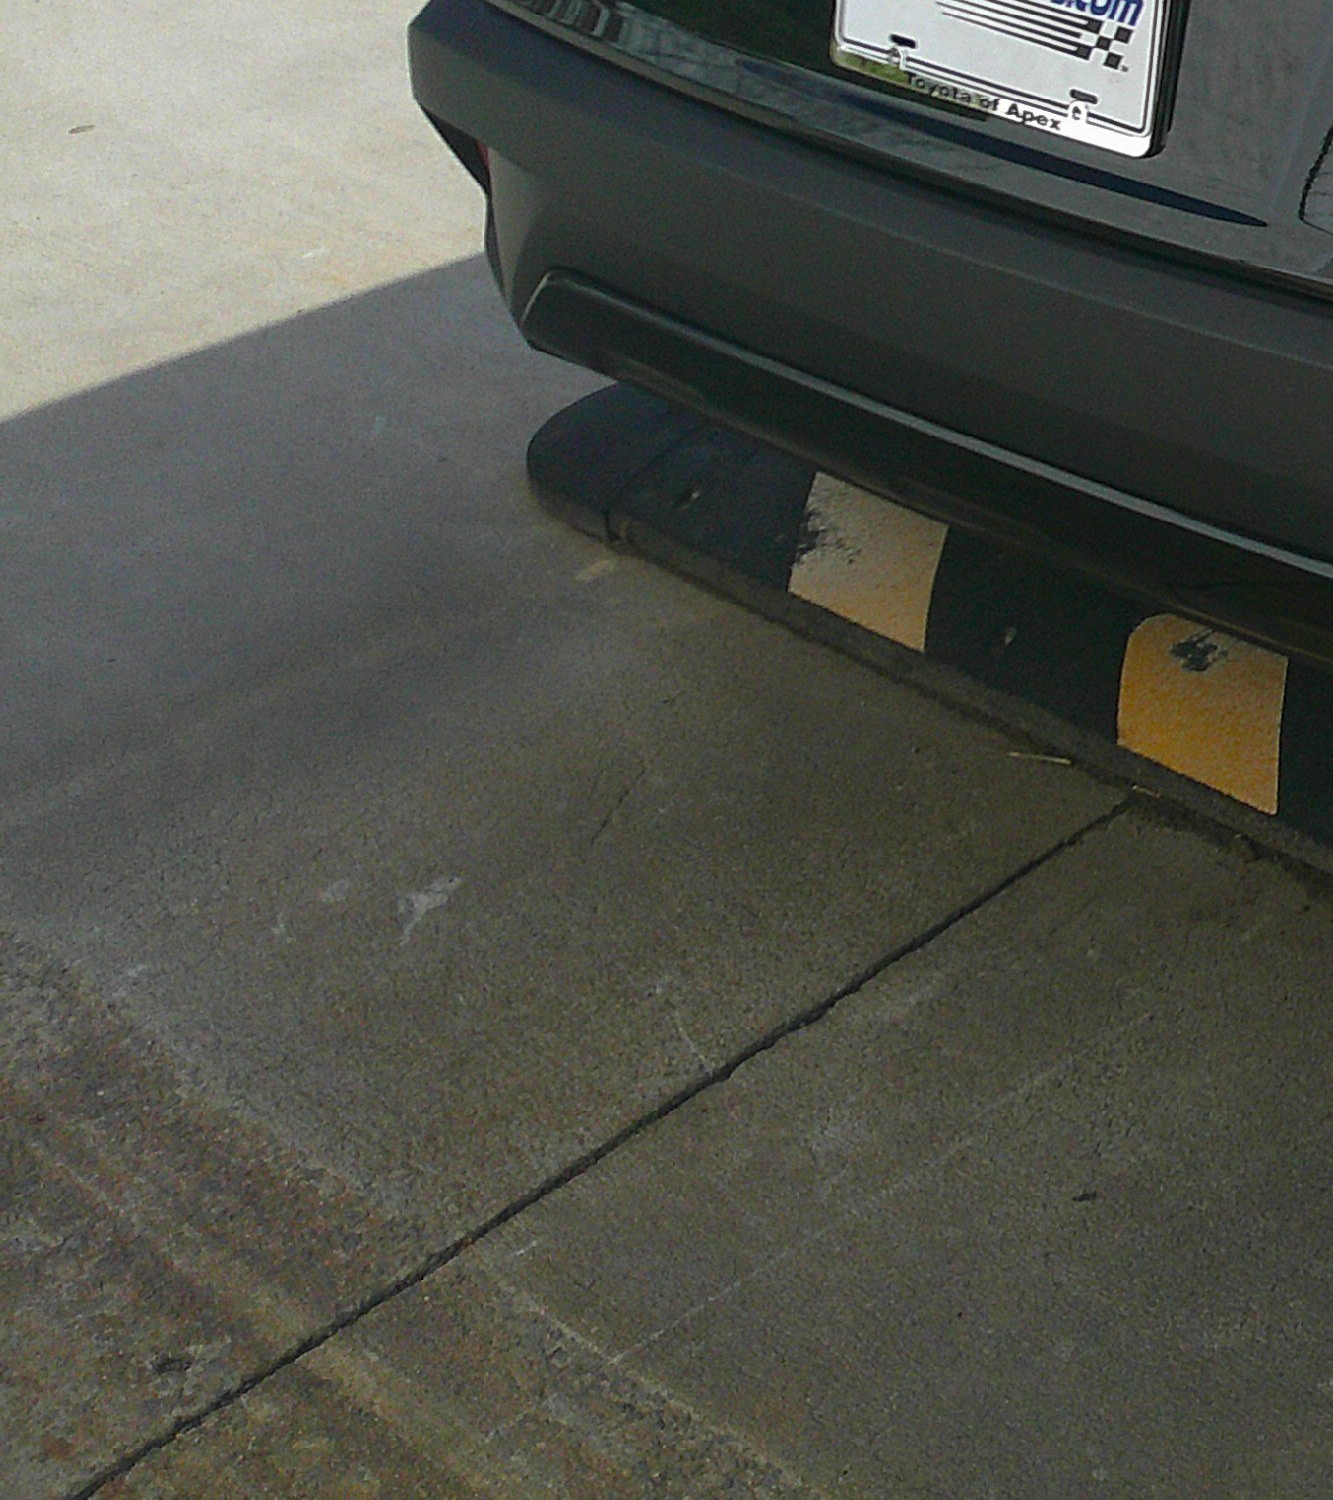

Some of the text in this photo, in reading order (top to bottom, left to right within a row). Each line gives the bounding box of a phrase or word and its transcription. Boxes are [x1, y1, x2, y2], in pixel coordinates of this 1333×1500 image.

[905, 72, 1063, 131] Toyota of Apex
